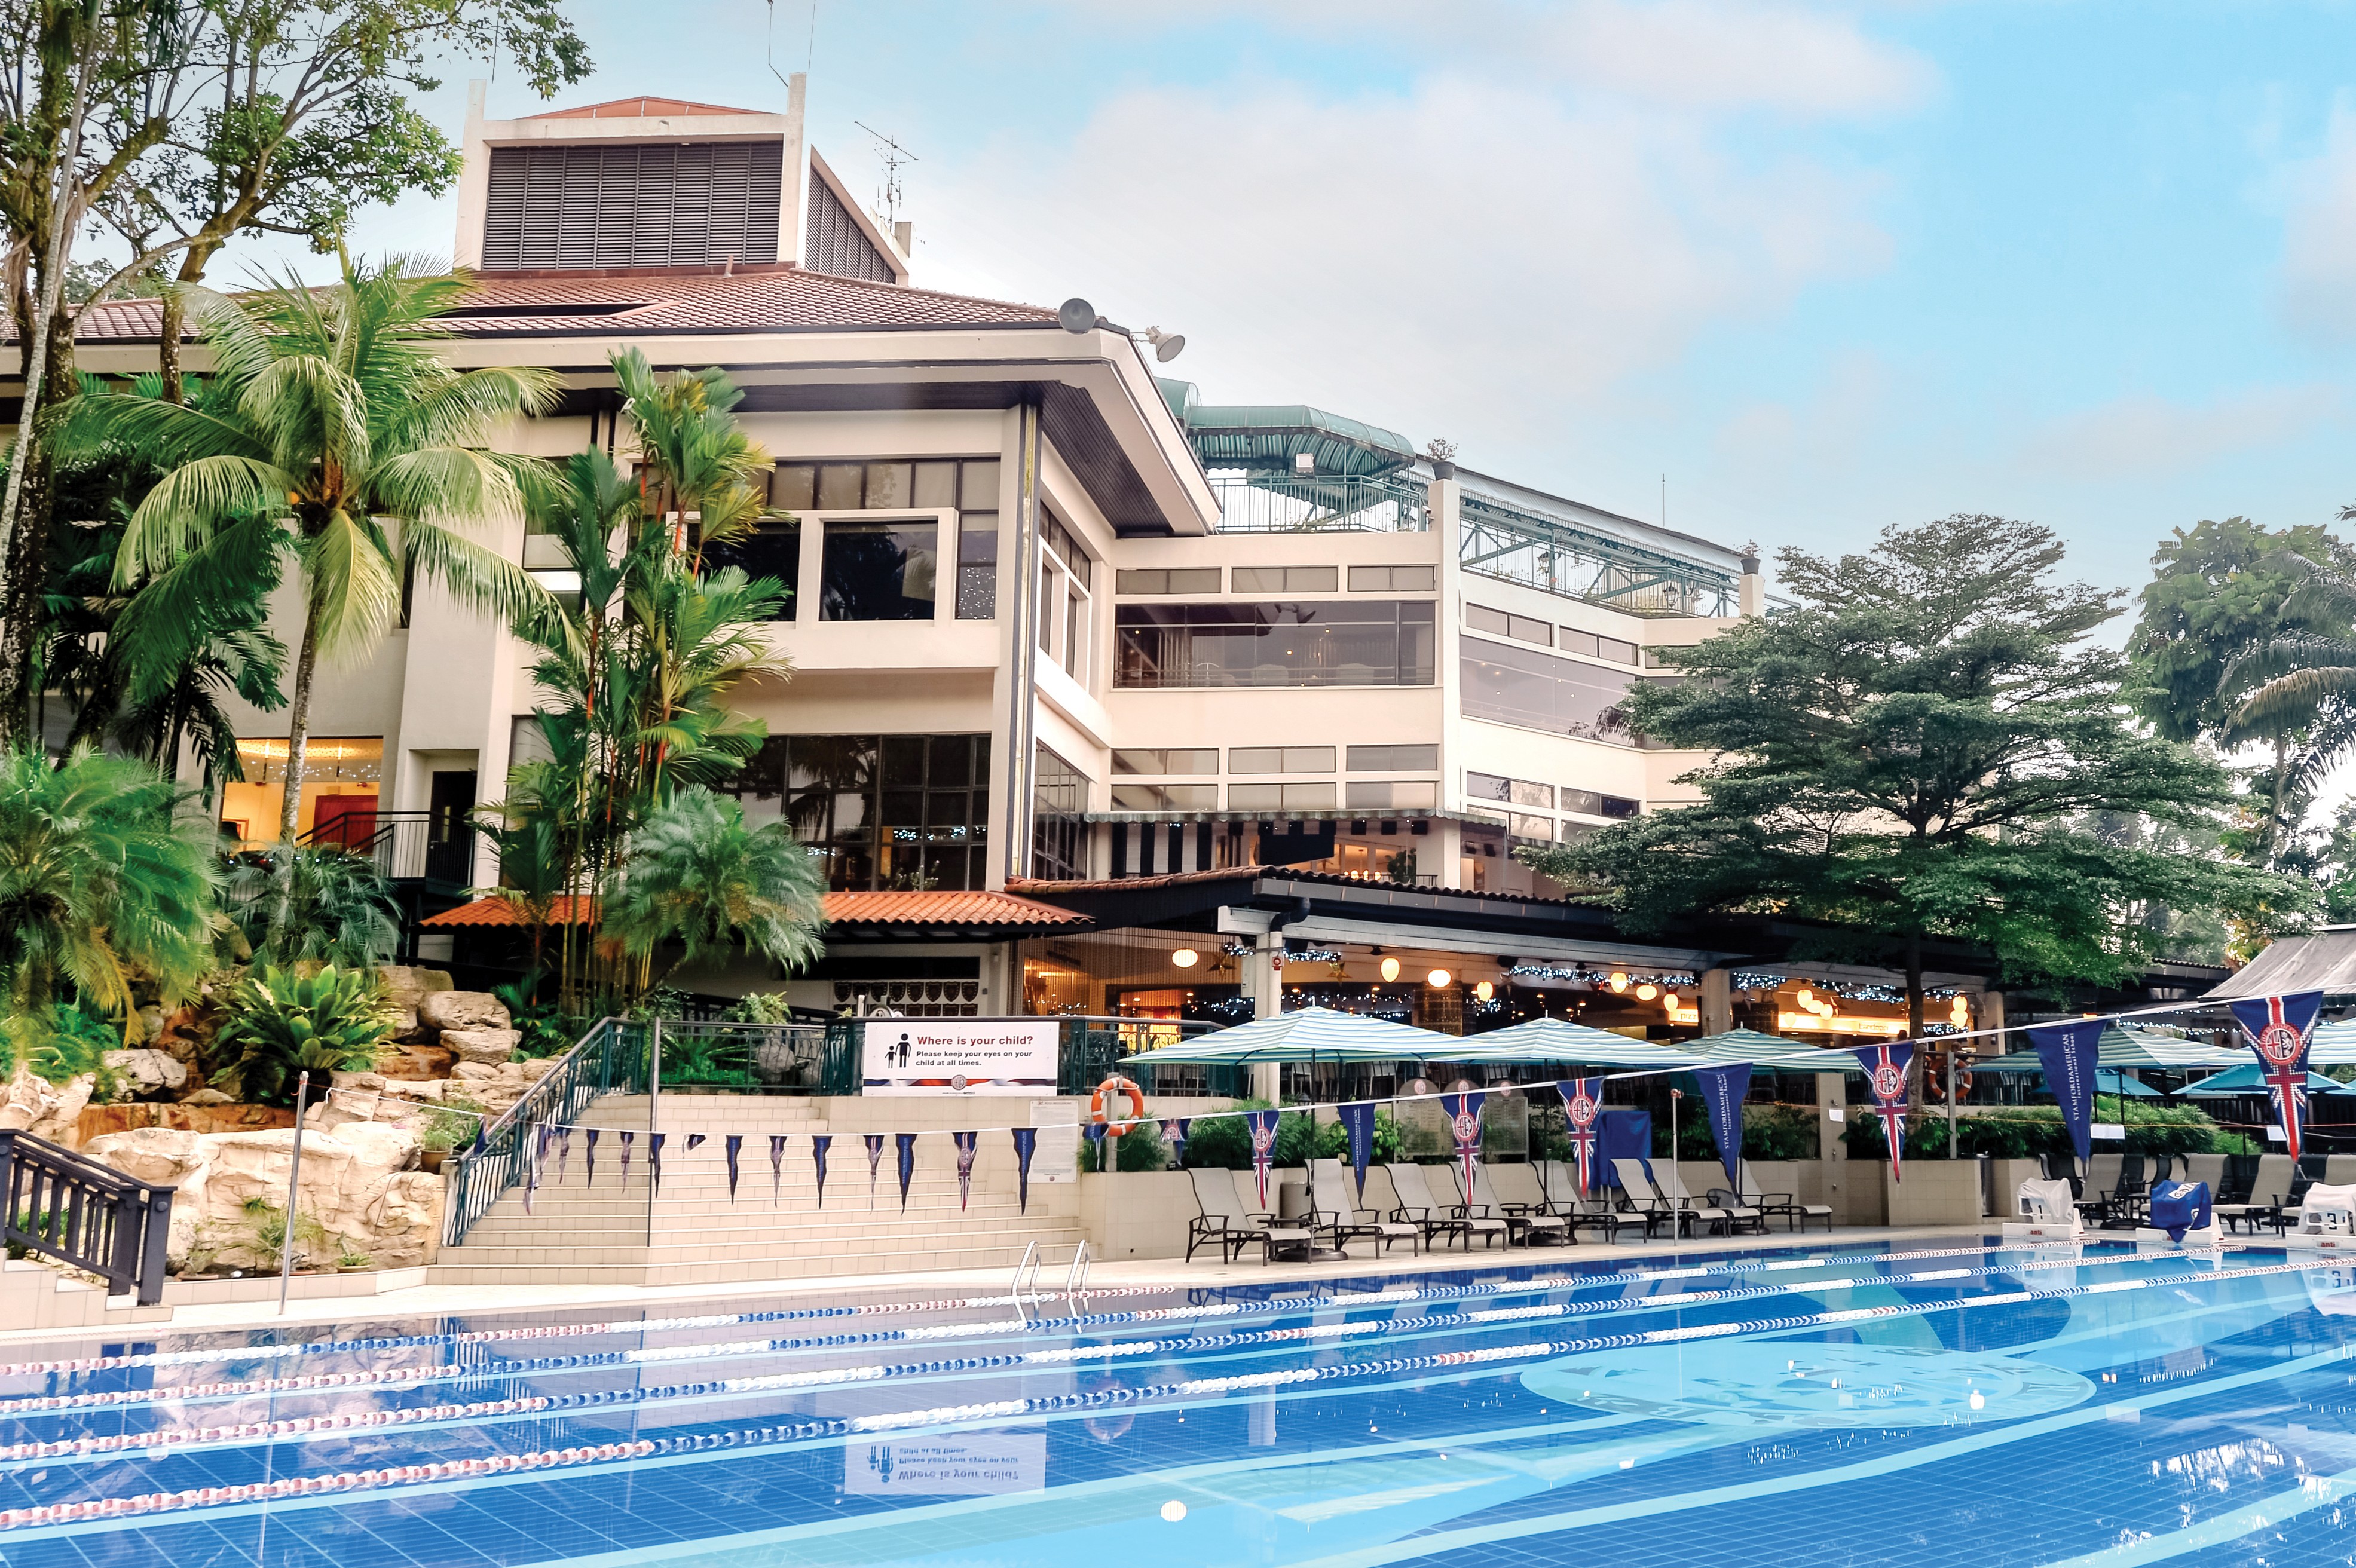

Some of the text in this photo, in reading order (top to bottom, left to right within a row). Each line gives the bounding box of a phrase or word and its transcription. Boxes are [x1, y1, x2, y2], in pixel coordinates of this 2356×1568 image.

[917, 1036, 1033, 1046] Where is your child?
[2072, 1056, 2082, 1098] International
[2038, 1205, 2043, 1219] 1
[2327, 1212, 2337, 1230] 3
